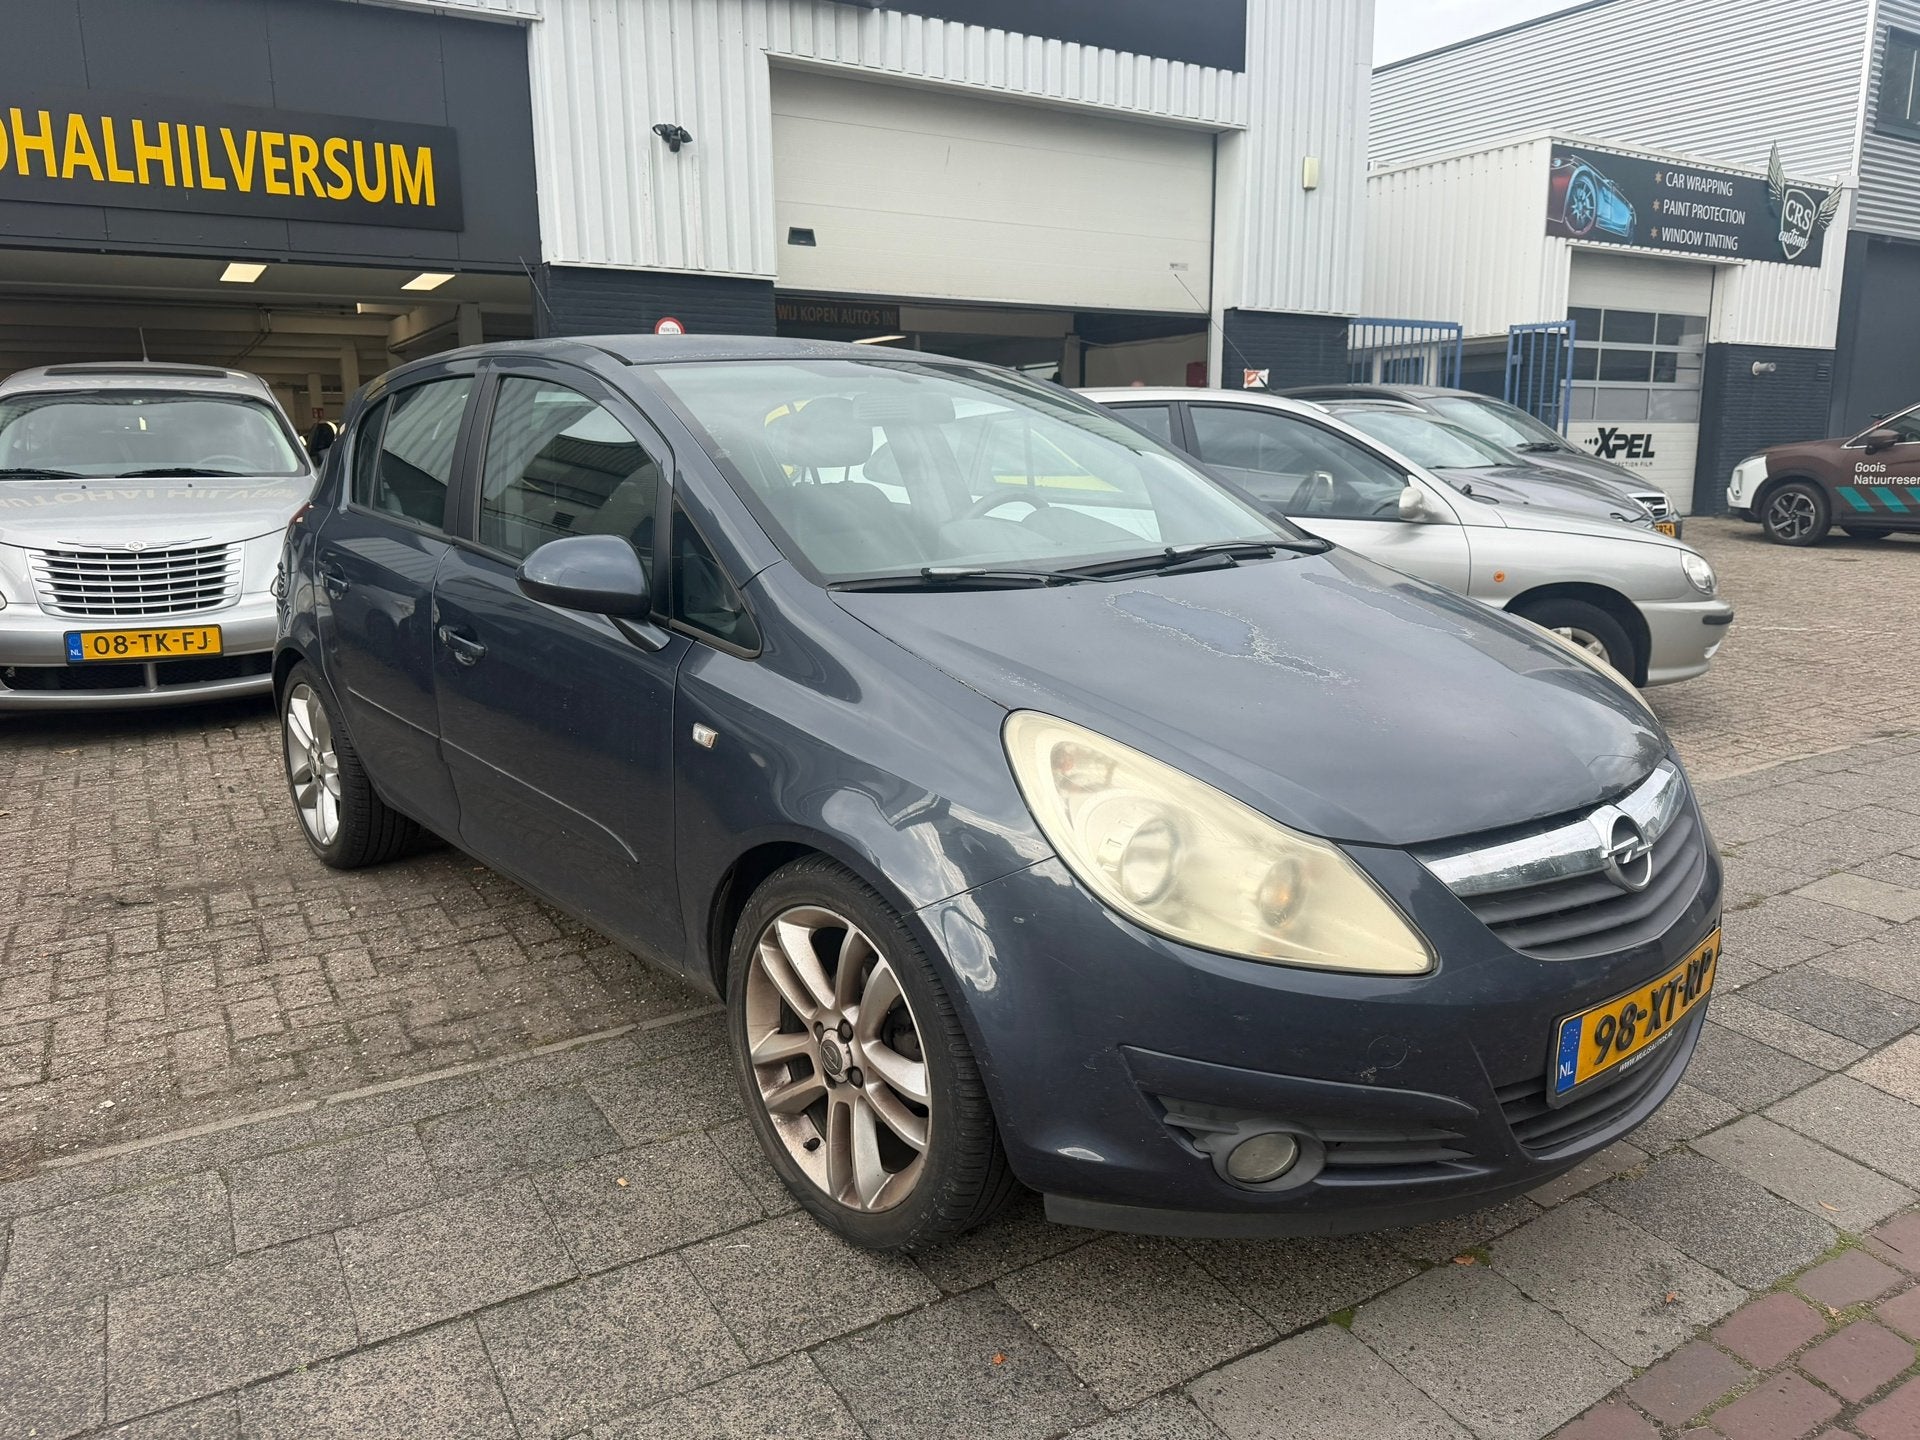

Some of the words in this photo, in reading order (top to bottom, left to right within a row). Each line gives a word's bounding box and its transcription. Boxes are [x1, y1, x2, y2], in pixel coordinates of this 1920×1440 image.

[0, 107, 436, 207] HALHILVERSUM
[1665, 172, 1685, 188] CAR
[1687, 175, 1733, 197] WRAPPING
[1663, 199, 1691, 217] PAINT
[1692, 203, 1746, 225] PROTECTION
[1785, 199, 1812, 231] CRS
[1661, 227, 1703, 246] WINDOW
[1705, 232, 1738, 251] TINTING
[1778, 228, 1809, 250] customs
[800, 305, 838, 323] KOPEN
[841, 308, 880, 325] AUTO'S
[1594, 427, 1656, 459] XPEL
[1855, 461, 1887, 473] Goois
[93, 631, 209, 655] 08-TK-FJ
[1593, 947, 1714, 1066] 98-XT-RP
[1559, 1062, 1574, 1079] NL
